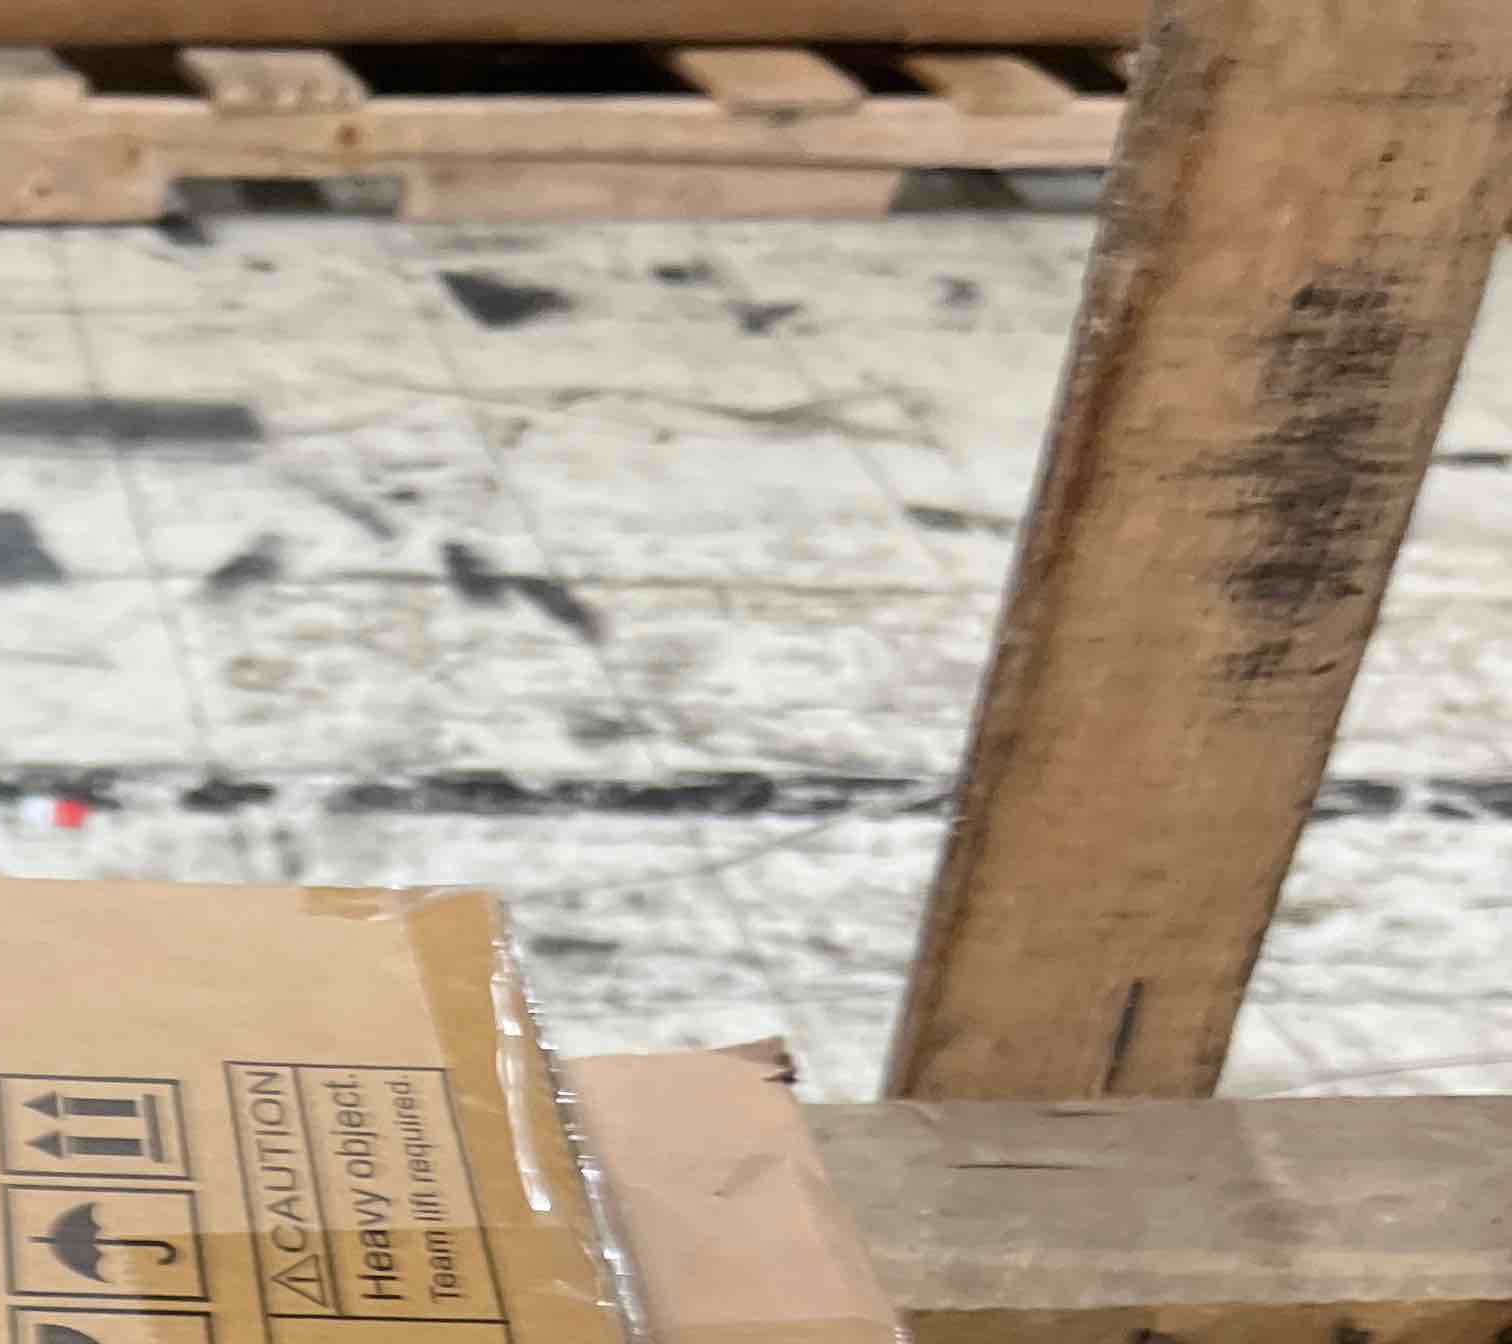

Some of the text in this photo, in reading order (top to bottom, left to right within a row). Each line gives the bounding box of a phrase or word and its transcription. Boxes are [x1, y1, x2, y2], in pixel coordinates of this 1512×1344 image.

[244, 1070, 307, 1254] CAUTION
[320, 1073, 409, 1301] Heavy object.
[407, 1190, 448, 1222] lift
[422, 1230, 466, 1304] Team
